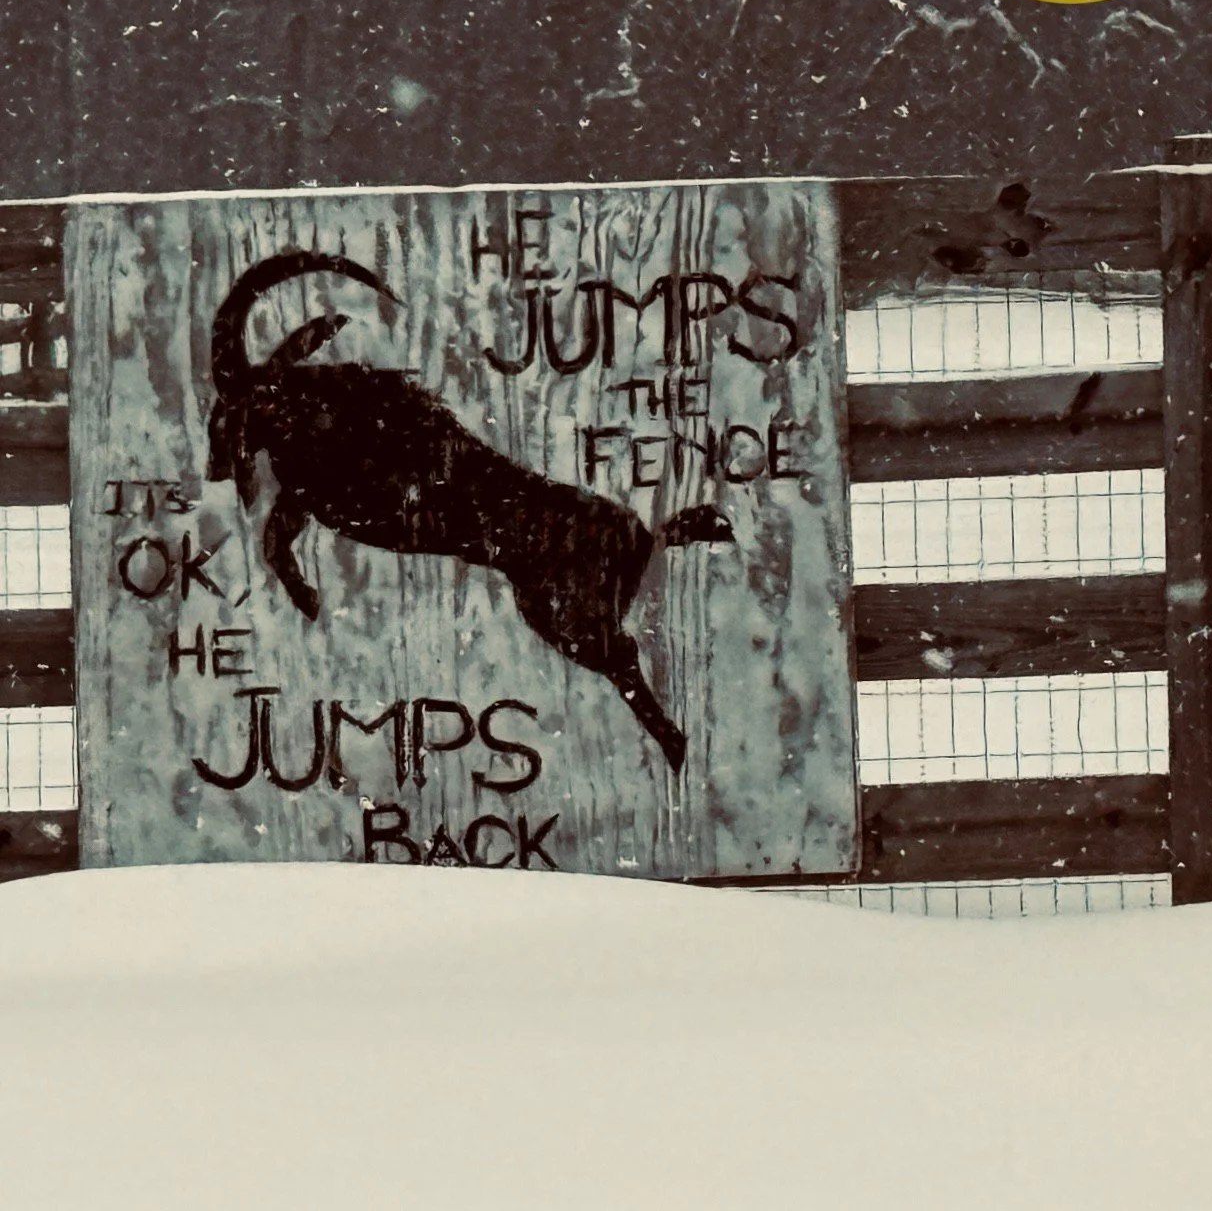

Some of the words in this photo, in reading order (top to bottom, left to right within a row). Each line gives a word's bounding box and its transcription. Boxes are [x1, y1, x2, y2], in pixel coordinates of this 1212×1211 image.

[470, 208, 554, 283] HE
[481, 271, 800, 375] JUMPS
[604, 378, 710, 418] THE
[580, 422, 814, 487] FENCE
[168, 623, 254, 679] HE
[191, 685, 543, 795] JUMPS
[361, 801, 561, 871] BACK
